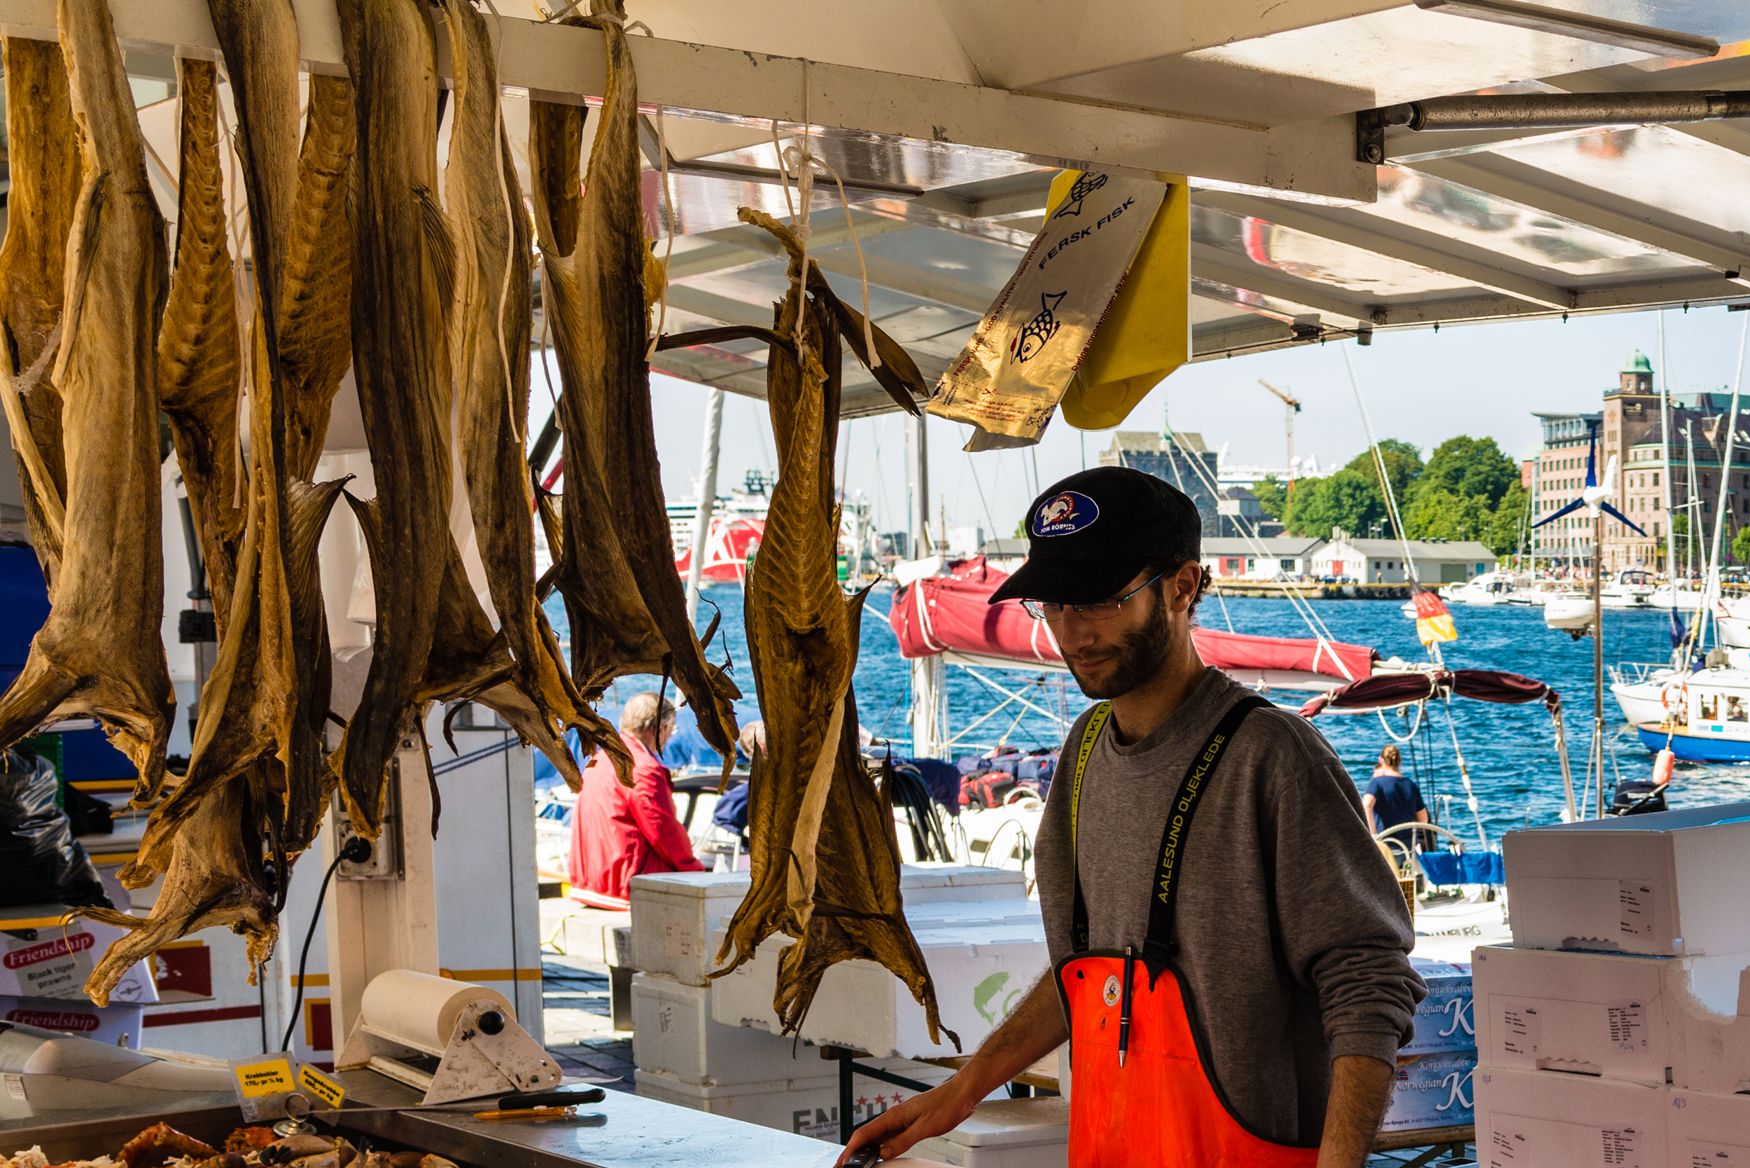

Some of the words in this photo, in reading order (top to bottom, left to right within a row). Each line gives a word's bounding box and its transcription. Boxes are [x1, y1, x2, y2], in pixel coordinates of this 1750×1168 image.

[1038, 227, 1092, 270] FERSK
[1097, 195, 1136, 230] FISK
[1157, 812, 1184, 904] AALESUND
[1182, 732, 1226, 813] OLJEKLEDE
[9, 936, 92, 967] Friendship
[28, 968, 52, 981] Black
[54, 962, 76, 976] tiger
[38, 974, 72, 989] prawns
[12, 1011, 96, 1030] Friendship
